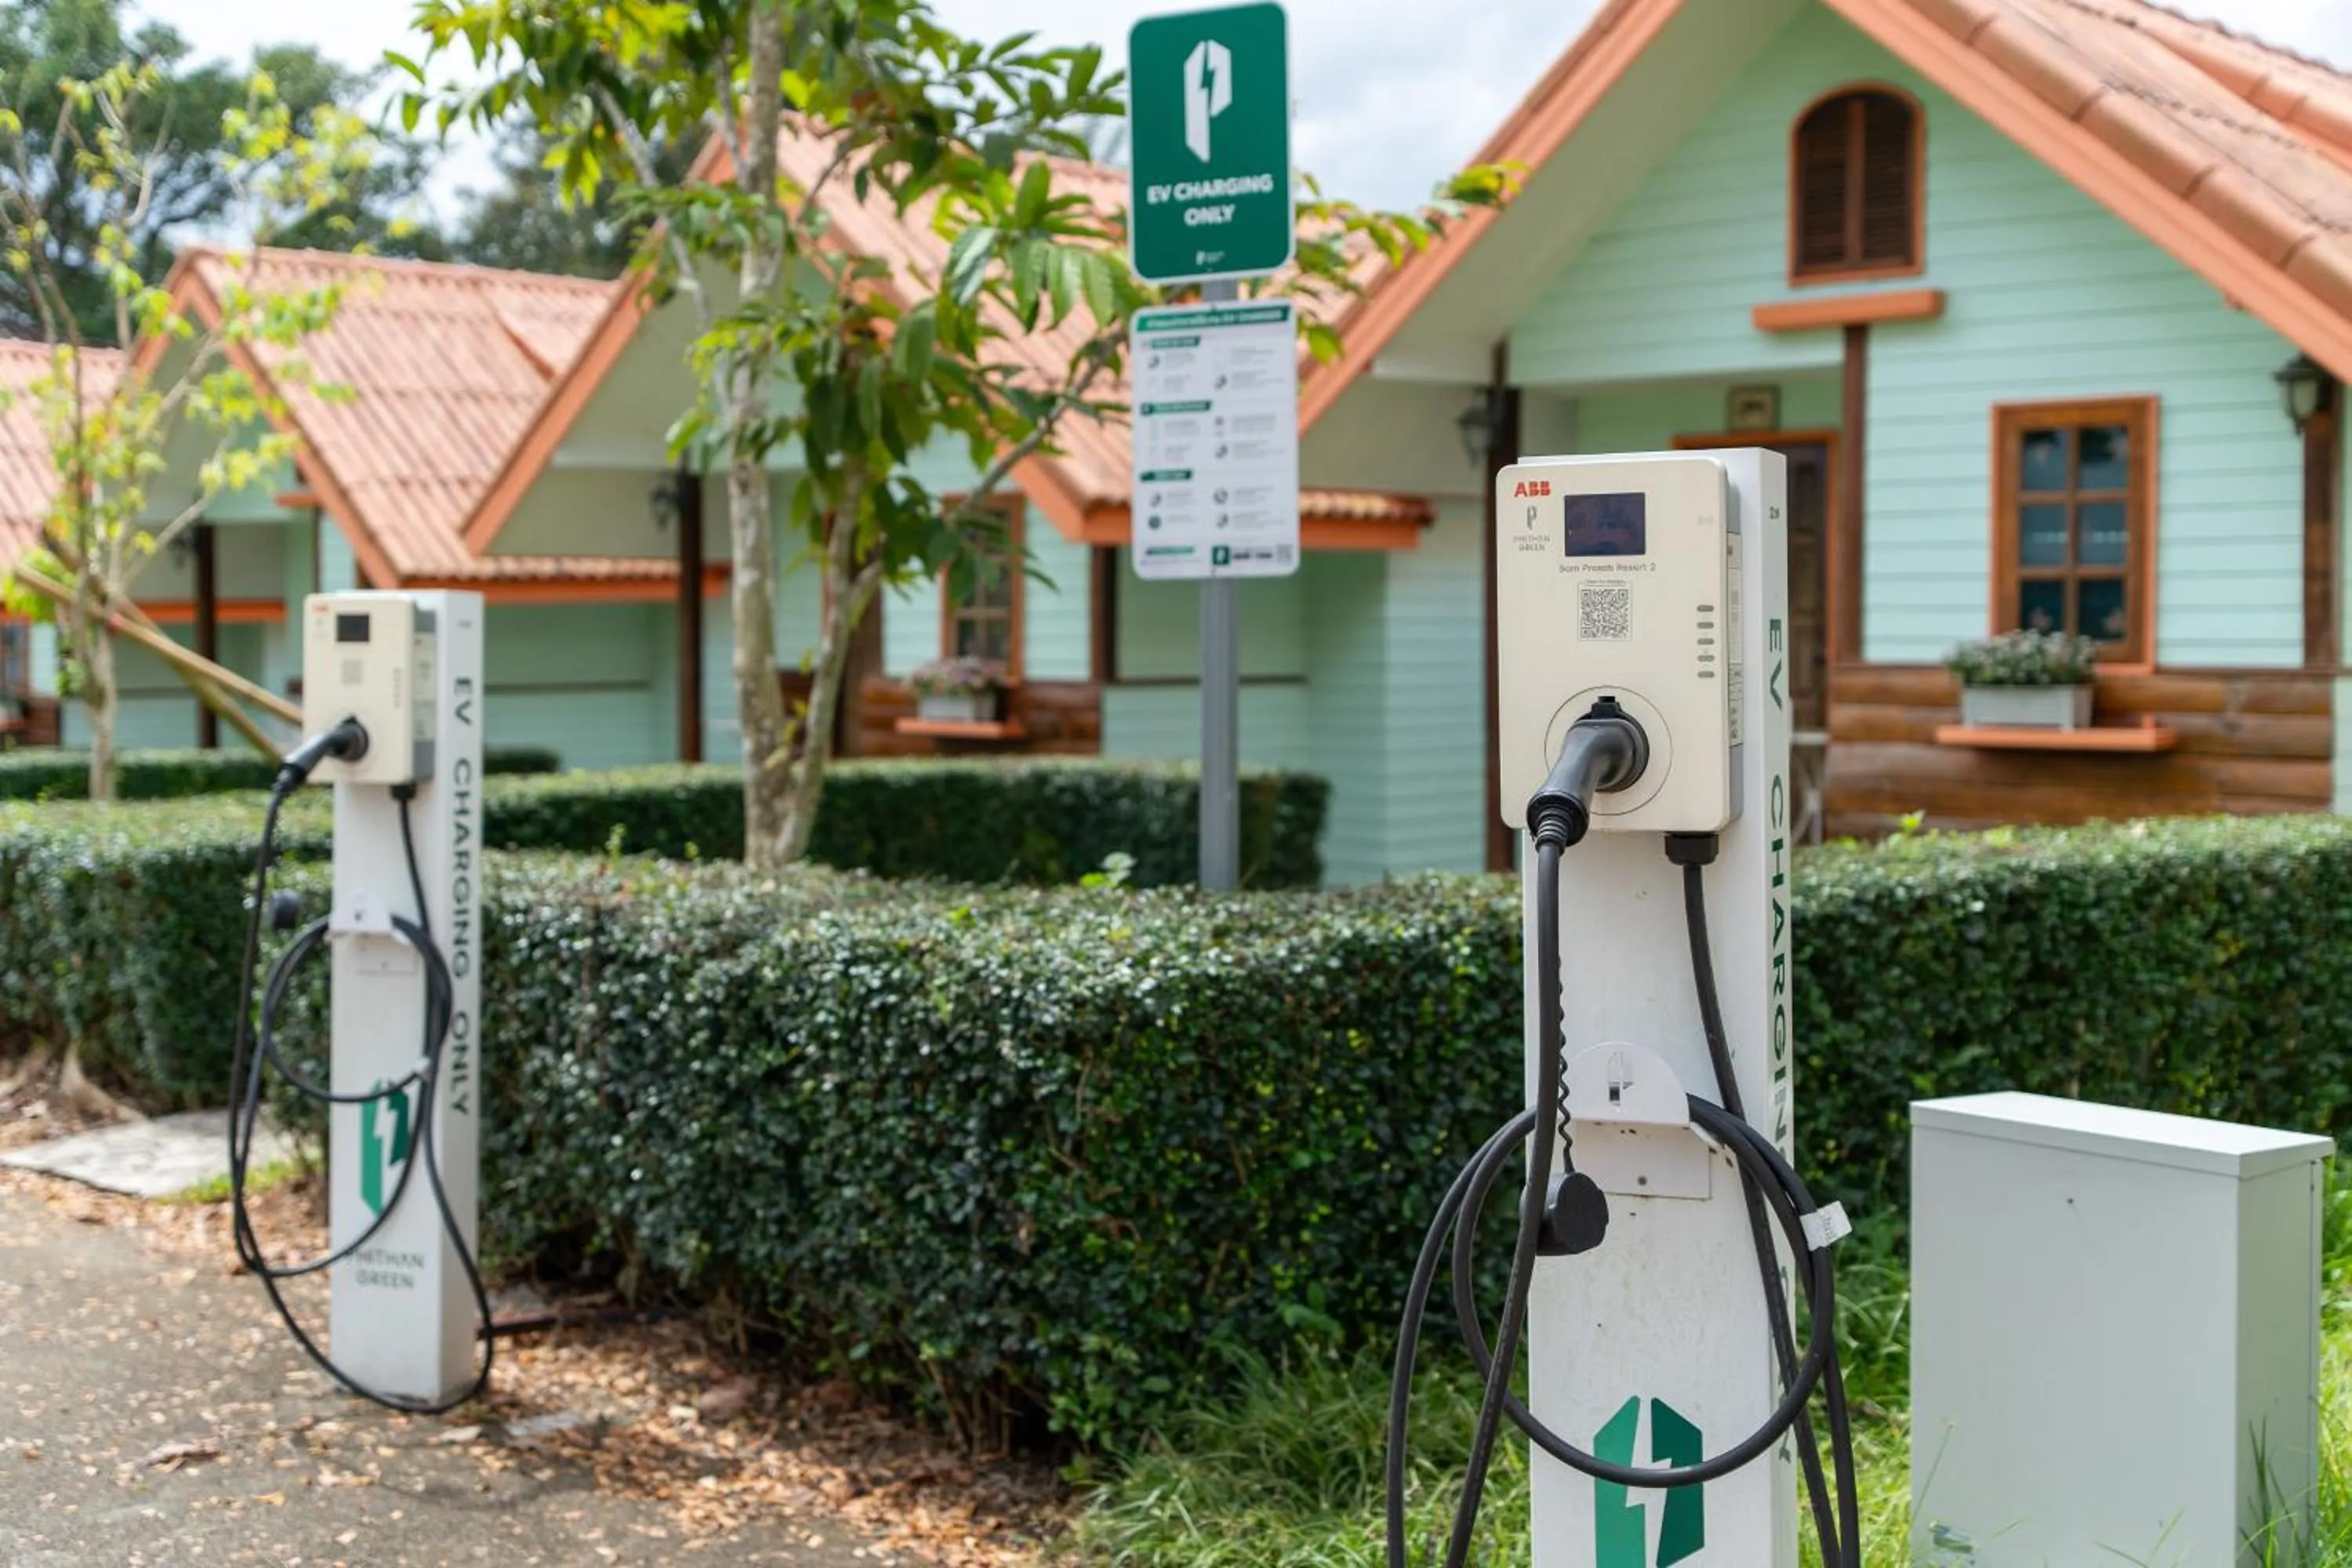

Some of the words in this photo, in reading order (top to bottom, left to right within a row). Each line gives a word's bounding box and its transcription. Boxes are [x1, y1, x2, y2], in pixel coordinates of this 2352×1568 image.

[1146, 184, 1172, 205] EV
[1174, 173, 1274, 201] CHARGING
[1184, 204, 1236, 227] ONLY
[1514, 481, 1551, 497] ABB
[1650, 562, 1657, 572] 2
[1769, 619, 1783, 711] EV
[453, 676, 472, 725] EV
[452, 757, 472, 980] CHARGING
[1770, 775, 1787, 1160] CHARGIN
[450, 1011, 470, 1116] ONLY
